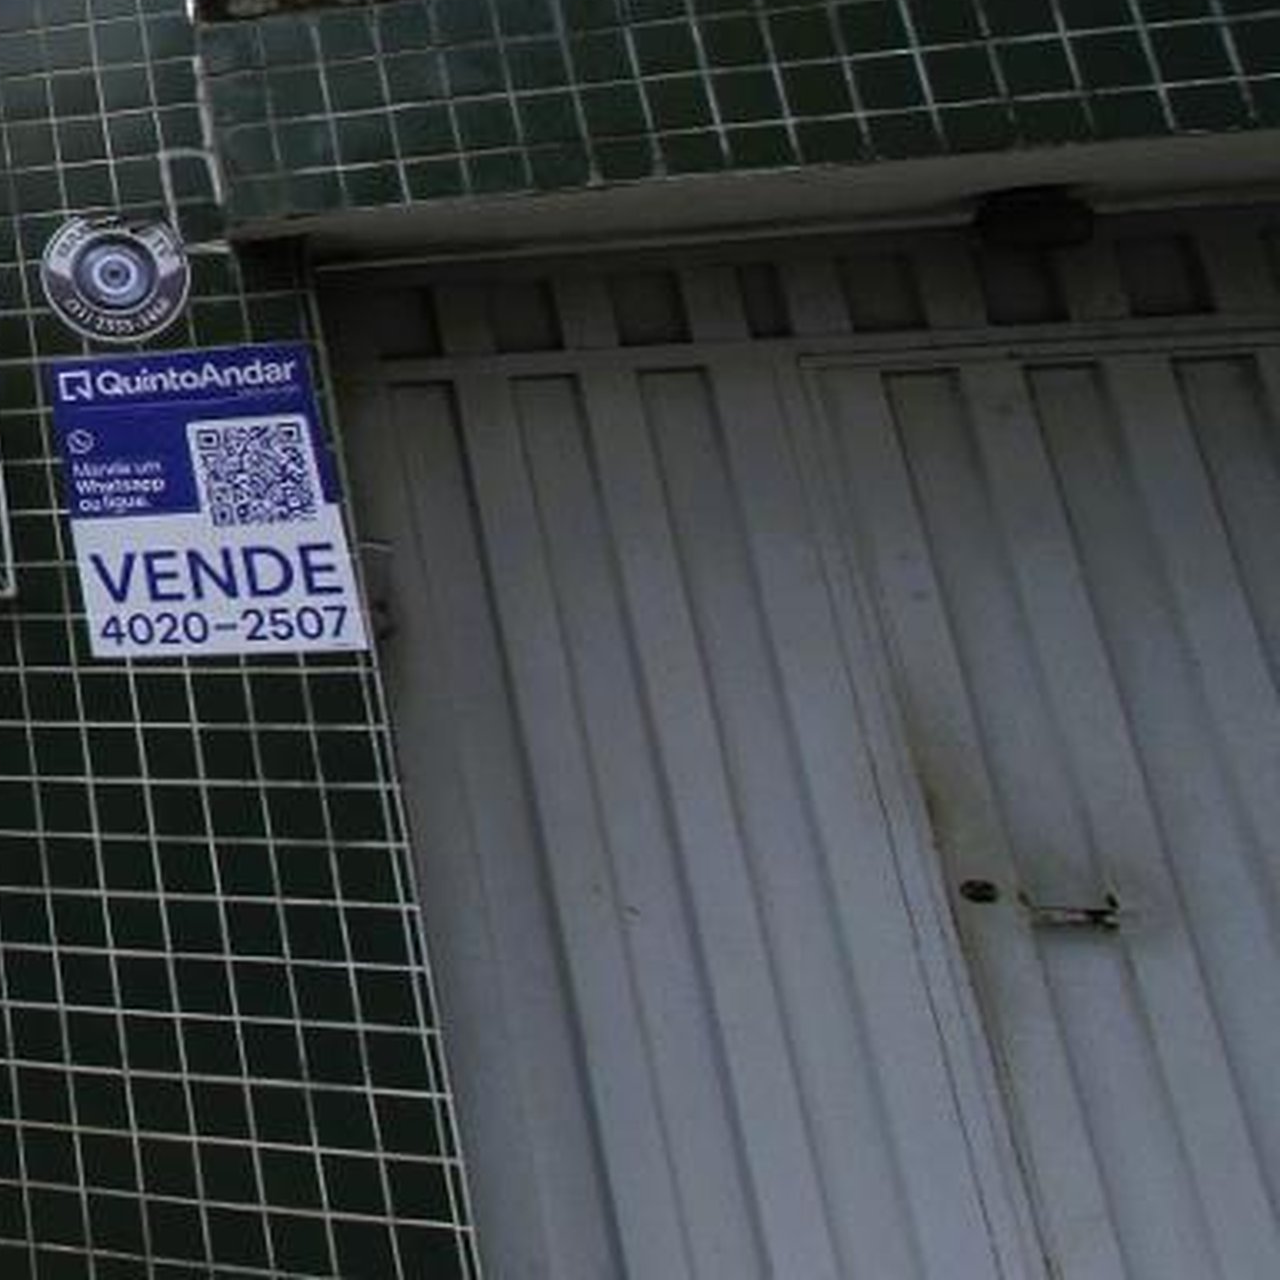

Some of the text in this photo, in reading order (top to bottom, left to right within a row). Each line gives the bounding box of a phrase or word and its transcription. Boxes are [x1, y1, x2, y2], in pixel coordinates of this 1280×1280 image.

[96, 360, 297, 396] QuintoAndar
[89, 542, 344, 603] VENDE
[100, 606, 348, 646] 4020-2507
